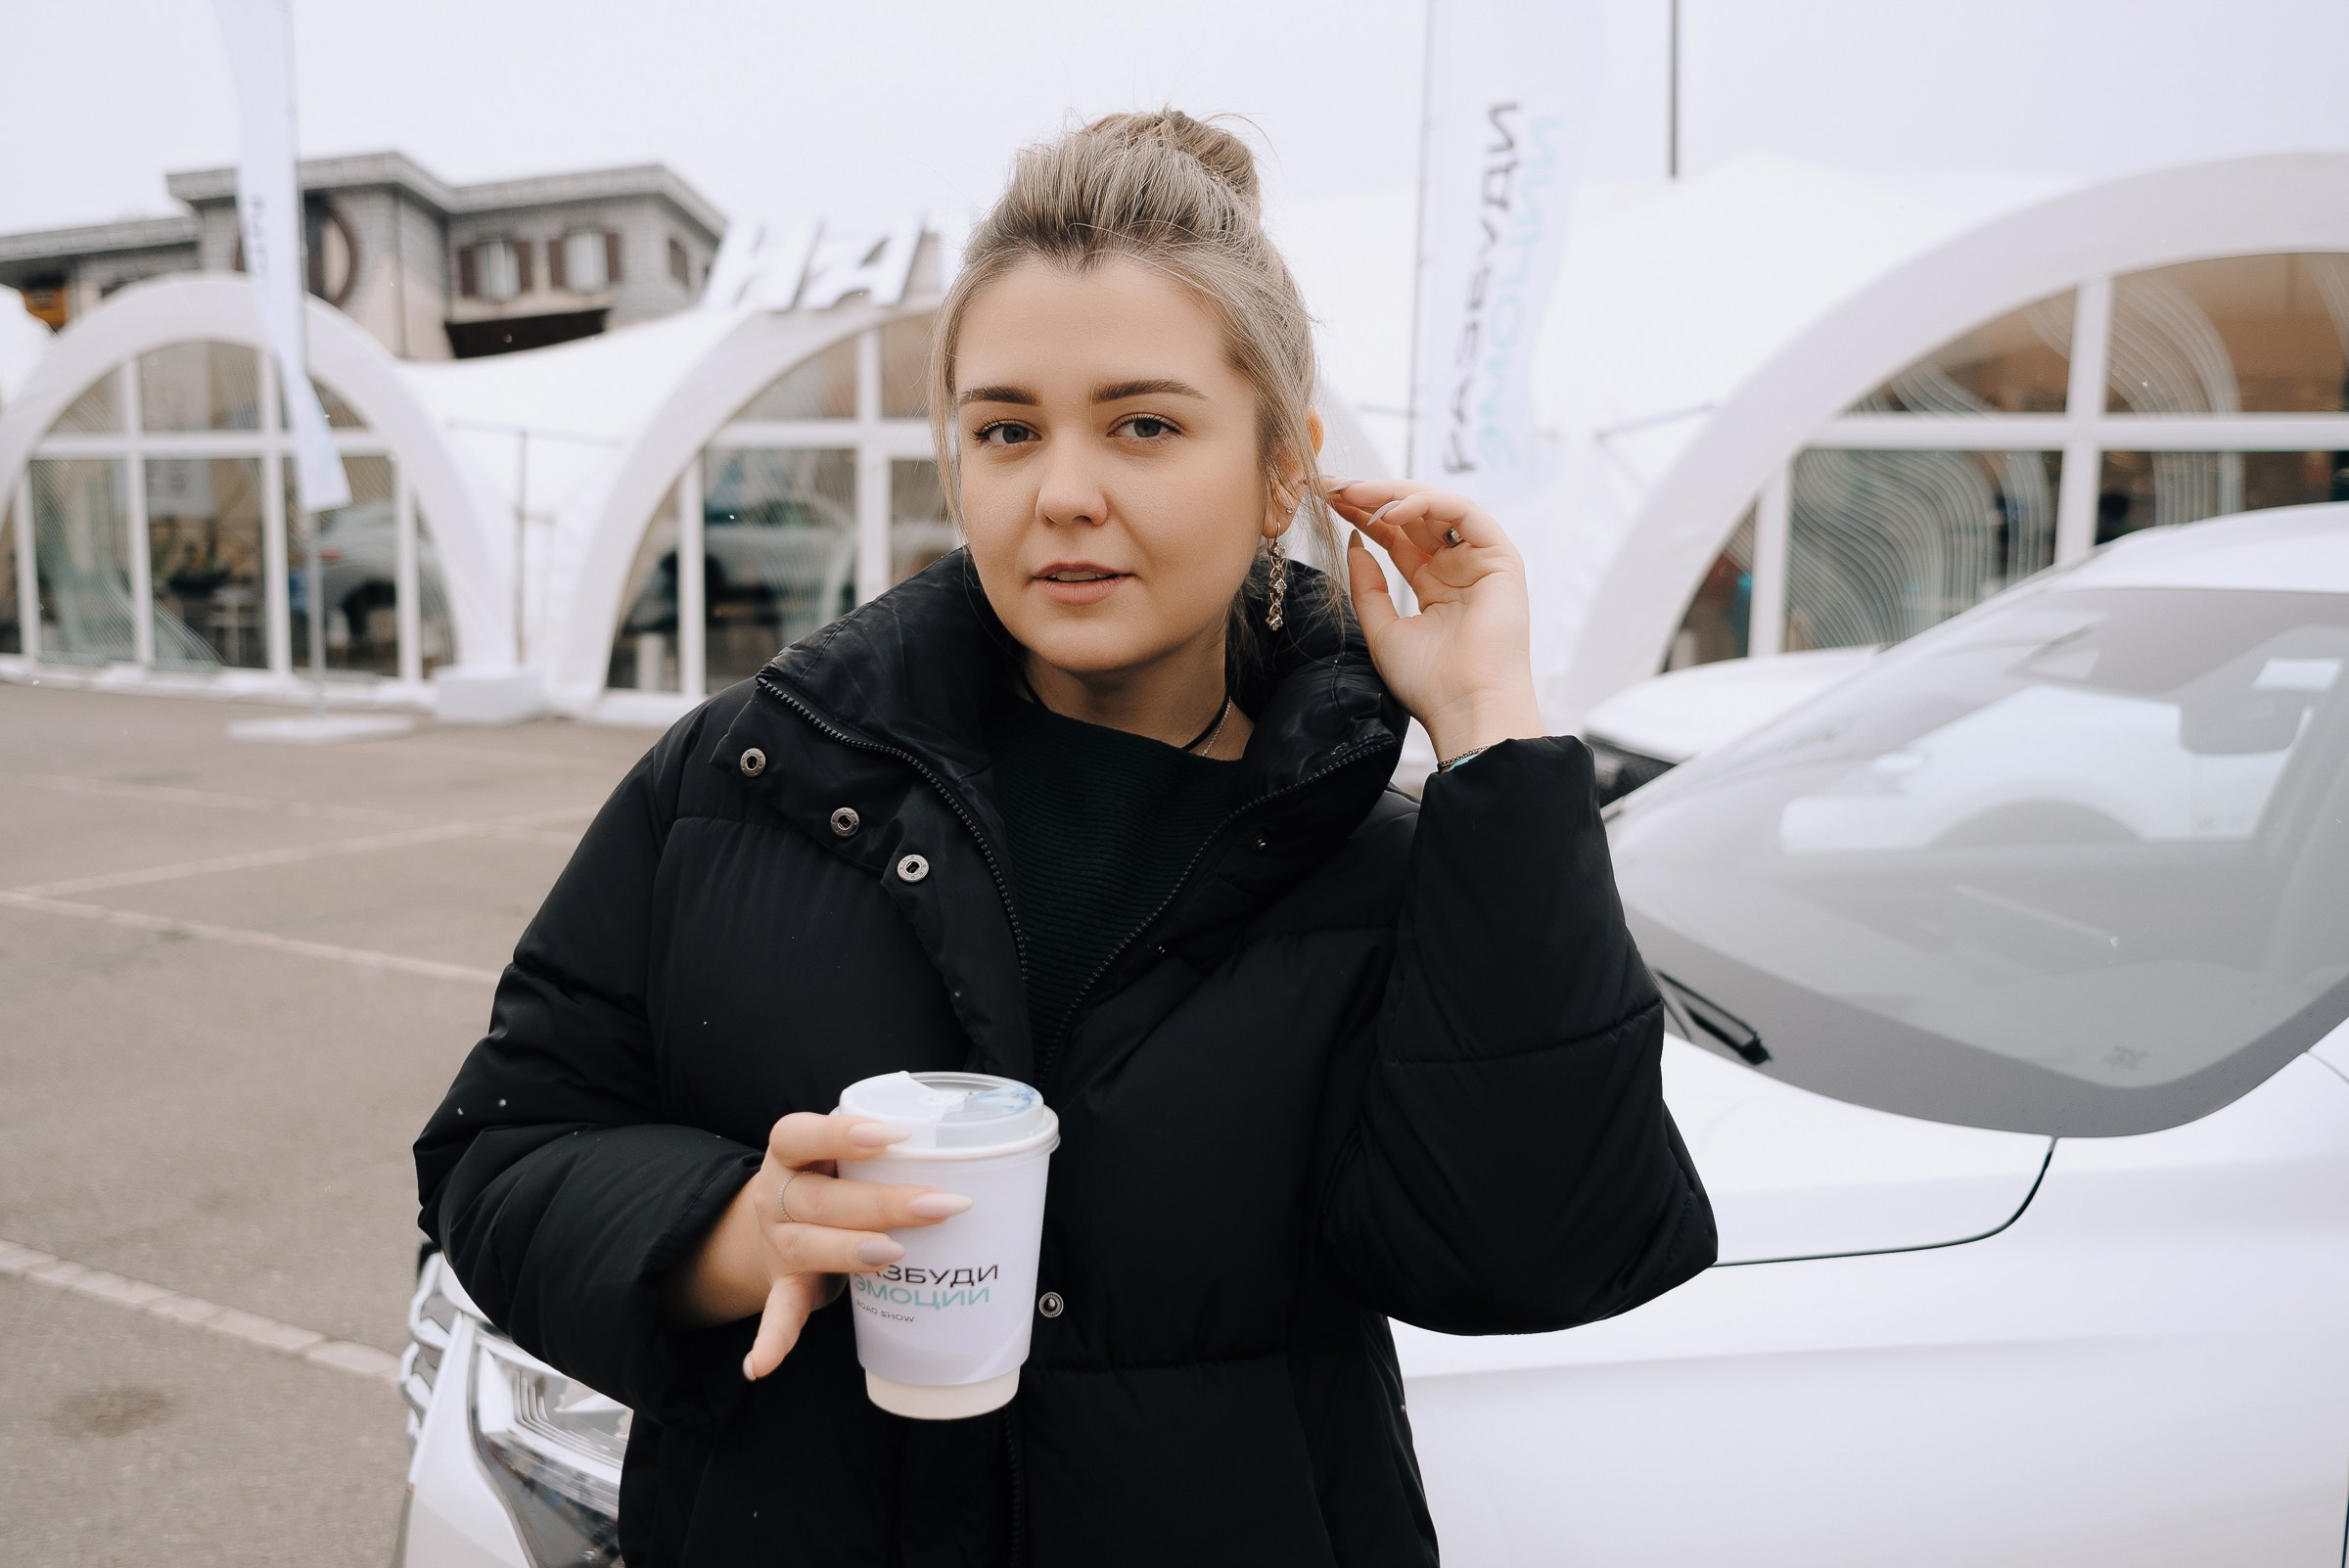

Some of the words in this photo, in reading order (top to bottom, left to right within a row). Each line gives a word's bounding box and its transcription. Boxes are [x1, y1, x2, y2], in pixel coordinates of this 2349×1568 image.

[1443, 101, 1520, 475] РАЗБУДИ
[1477, 115, 1563, 469] ЭМОЦИИ
[853, 1273, 990, 1311] ЭМОЦИИ
[874, 1263, 999, 1288] ЗБУДИ
[881, 1310, 915, 1322] SHOW
